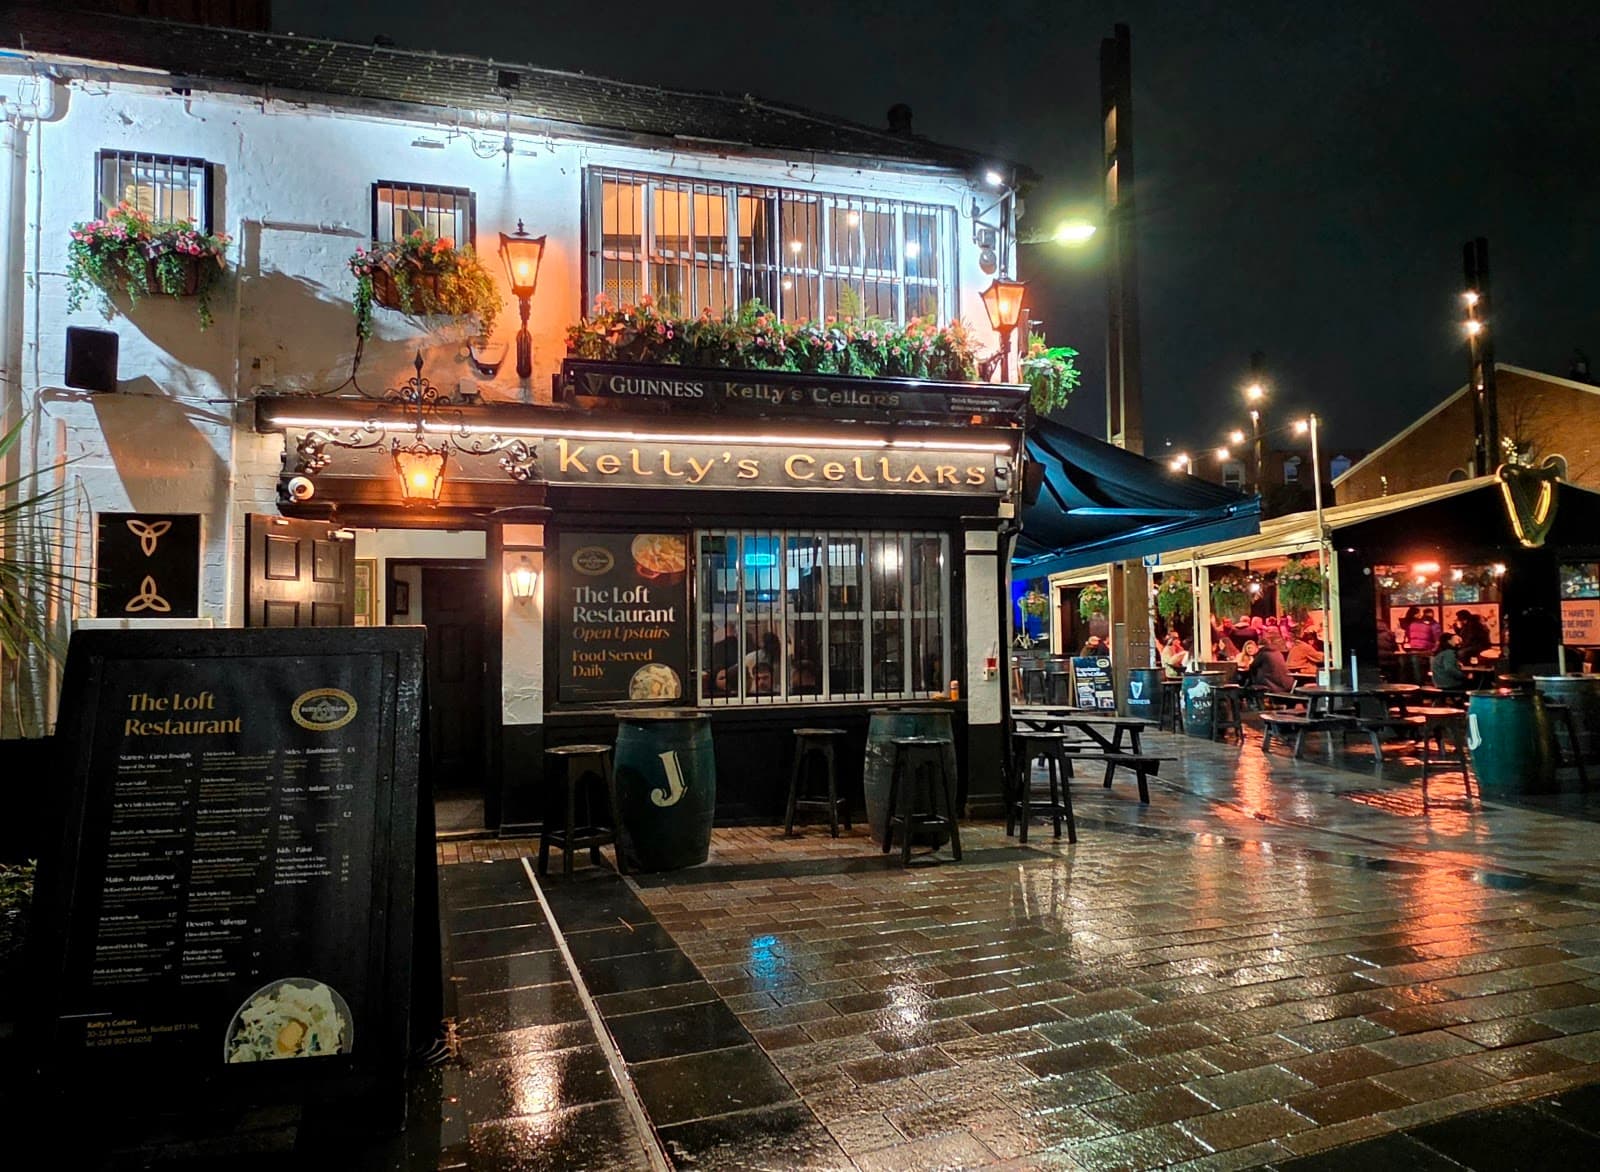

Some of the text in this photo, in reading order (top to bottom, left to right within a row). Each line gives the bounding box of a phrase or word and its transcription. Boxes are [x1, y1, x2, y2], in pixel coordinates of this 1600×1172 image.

[610, 376, 900, 406] GUINNESS Kelly's Cellars
[556, 438, 760, 484] Kelly's
[572, 585, 651, 604] The Loft
[573, 606, 676, 623] Restaurant
[573, 625, 670, 642] Open Upstairs
[572, 648, 653, 662] Food Served
[572, 664, 604, 680] Daily
[128, 691, 216, 711] The Loft
[124, 716, 242, 737] Restaurant
[650, 750, 688, 807] J
